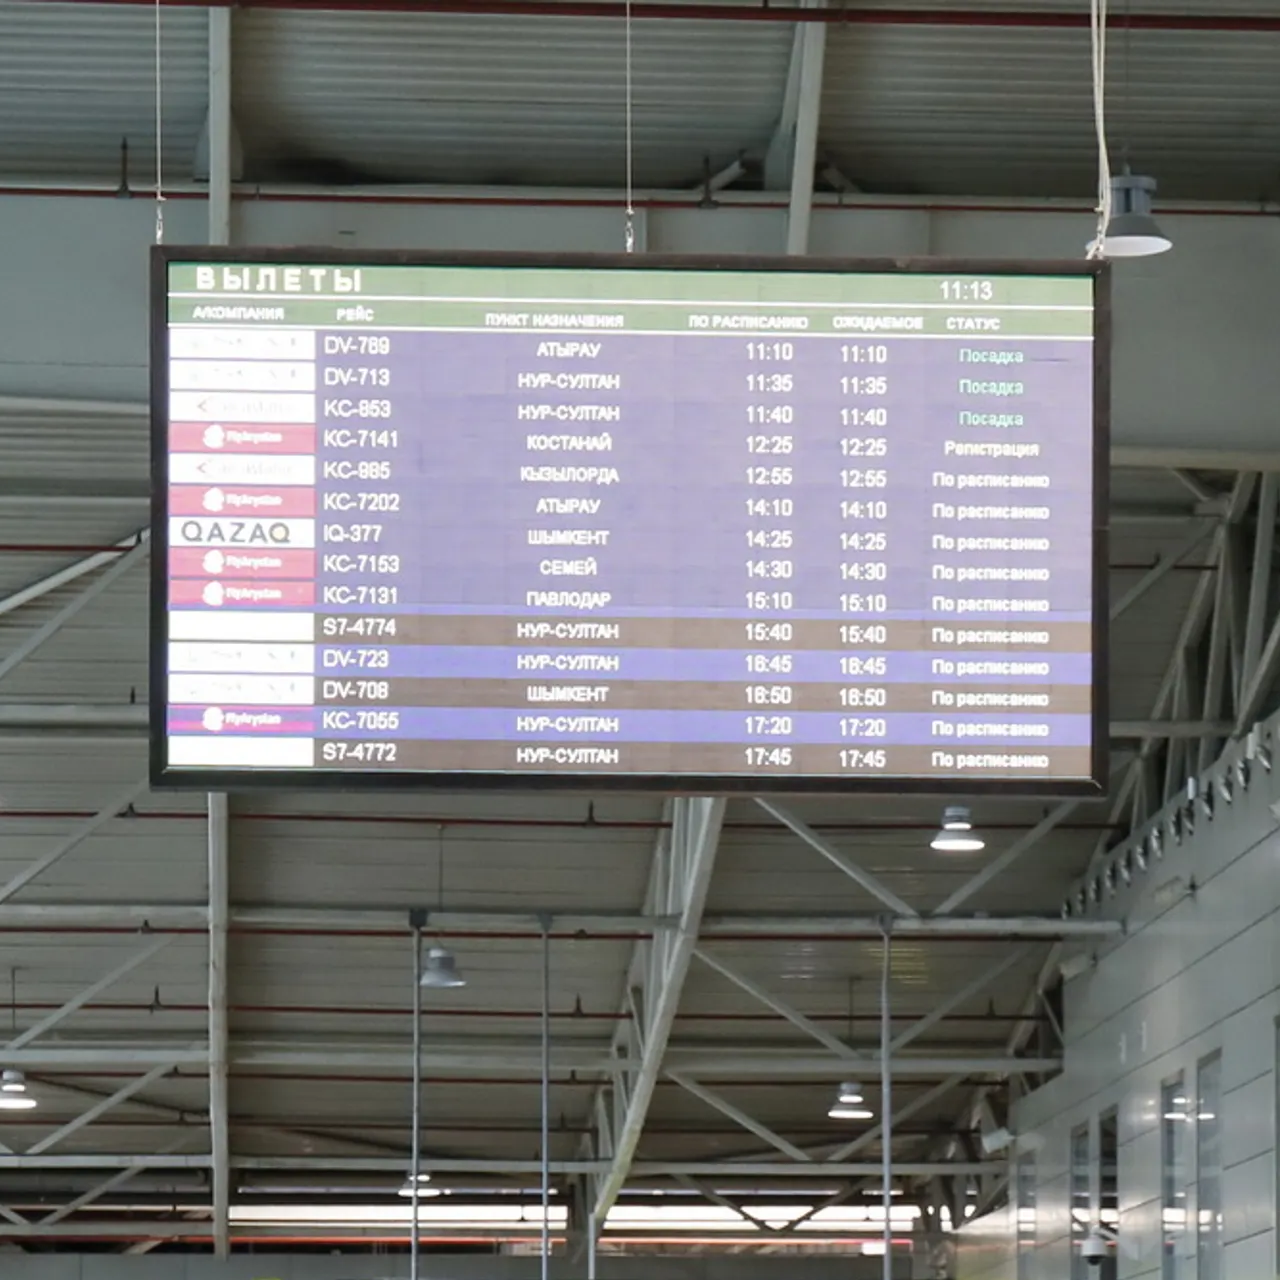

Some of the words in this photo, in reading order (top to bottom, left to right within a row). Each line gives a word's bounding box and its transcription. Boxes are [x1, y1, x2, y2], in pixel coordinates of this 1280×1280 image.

[195, 266, 361, 293] ВЫЛЕТЫ
[941, 281, 992, 300] 11:13
[337, 305, 374, 321] РЕЙС
[484, 313, 529, 329] ПУНКТ
[531, 314, 624, 330] НАЗНАЧЕНИЯ
[689, 315, 709, 328] ПО
[712, 315, 808, 329] РАСПИСАНИЮ
[833, 316, 923, 331] ОЖИДАЕМОЕ
[947, 317, 1000, 330] СТАТУС
[537, 342, 601, 357] АТЫРАУ
[747, 343, 793, 360] 11:10
[842, 346, 886, 363] 11:10
[960, 349, 1023, 364] Посадка
[325, 368, 389, 386] DV-713
[519, 373, 620, 389] НУР-СУЛТАН
[747, 374, 793, 391] 11:35
[841, 377, 887, 394] 11:35
[960, 379, 1023, 396] Посадка
[325, 400, 391, 417] KC-853
[518, 405, 620, 421] НУР-СУЛТАН
[747, 406, 792, 423] 11:40
[841, 409, 886, 425] 11:40
[960, 411, 1023, 428] Посадка
[324, 430, 397, 447] KC-7141
[527, 432, 612, 450] КОСТАНАЙ
[747, 436, 792, 453] 12:25
[841, 438, 886, 456] 12:25
[945, 441, 1039, 458] Регистрация
[521, 467, 619, 484] КЫЗЫЛОРДА
[747, 467, 792, 484] 12:55
[841, 470, 886, 487] 12:55
[933, 472, 954, 486] По
[958, 475, 1050, 489] расписанию
[324, 493, 399, 510] KC-7202
[536, 498, 600, 513] АТЫРАУ
[747, 499, 792, 516] 14:10
[841, 501, 886, 518] 14:10
[933, 503, 954, 518] По
[958, 506, 1049, 520] расписанию
[181, 521, 291, 544] QAZAQ
[324, 524, 382, 542] IQ-377
[528, 530, 609, 545] ШЫМКЕНТ
[746, 531, 792, 548] 14:25
[841, 533, 886, 550] 14:25
[932, 535, 954, 549] По
[957, 538, 1049, 552] расписанию
[324, 555, 399, 572] KC-7153
[540, 557, 597, 575] СЕМЕЙ
[747, 561, 792, 577] 14:30
[840, 563, 886, 580] 14:30
[933, 565, 954, 579] По
[957, 568, 1049, 581] расписанию
[324, 587, 396, 604] KC-7131
[527, 592, 611, 609] ПАВЛОДАР
[747, 592, 792, 609] 15:10
[840, 594, 886, 612] 15:10
[932, 596, 954, 611] По
[957, 599, 1049, 613] расписанию
[324, 618, 396, 635] S7-4774
[517, 623, 619, 638] НУР-СУЛТАН
[746, 623, 792, 640] 15:40
[840, 626, 886, 643] 15:40
[932, 628, 954, 642] По
[957, 631, 1049, 644] расписанию
[324, 650, 388, 667] DV-723
[517, 655, 619, 670] НУР-СУЛТАН
[932, 659, 954, 674] По
[957, 662, 1049, 676] расписанию
[324, 681, 388, 698] DV-708
[528, 686, 609, 701] ШЫМКЕНТ
[932, 690, 954, 705] По
[957, 693, 1049, 707] расписанию
[324, 712, 398, 729] KC-7055
[517, 717, 618, 732] НУР-СУЛТАН
[746, 717, 791, 734] 17:20
[840, 719, 885, 736] 17:20
[932, 721, 954, 735] По
[957, 724, 1049, 737] расписанию
[323, 743, 396, 761] S7-4772
[517, 748, 618, 763] НУР-СУЛТАН
[746, 748, 791, 765] 17:45
[840, 750, 885, 767] 17:45
[932, 752, 954, 767] По
[957, 755, 1049, 769] расписанию
